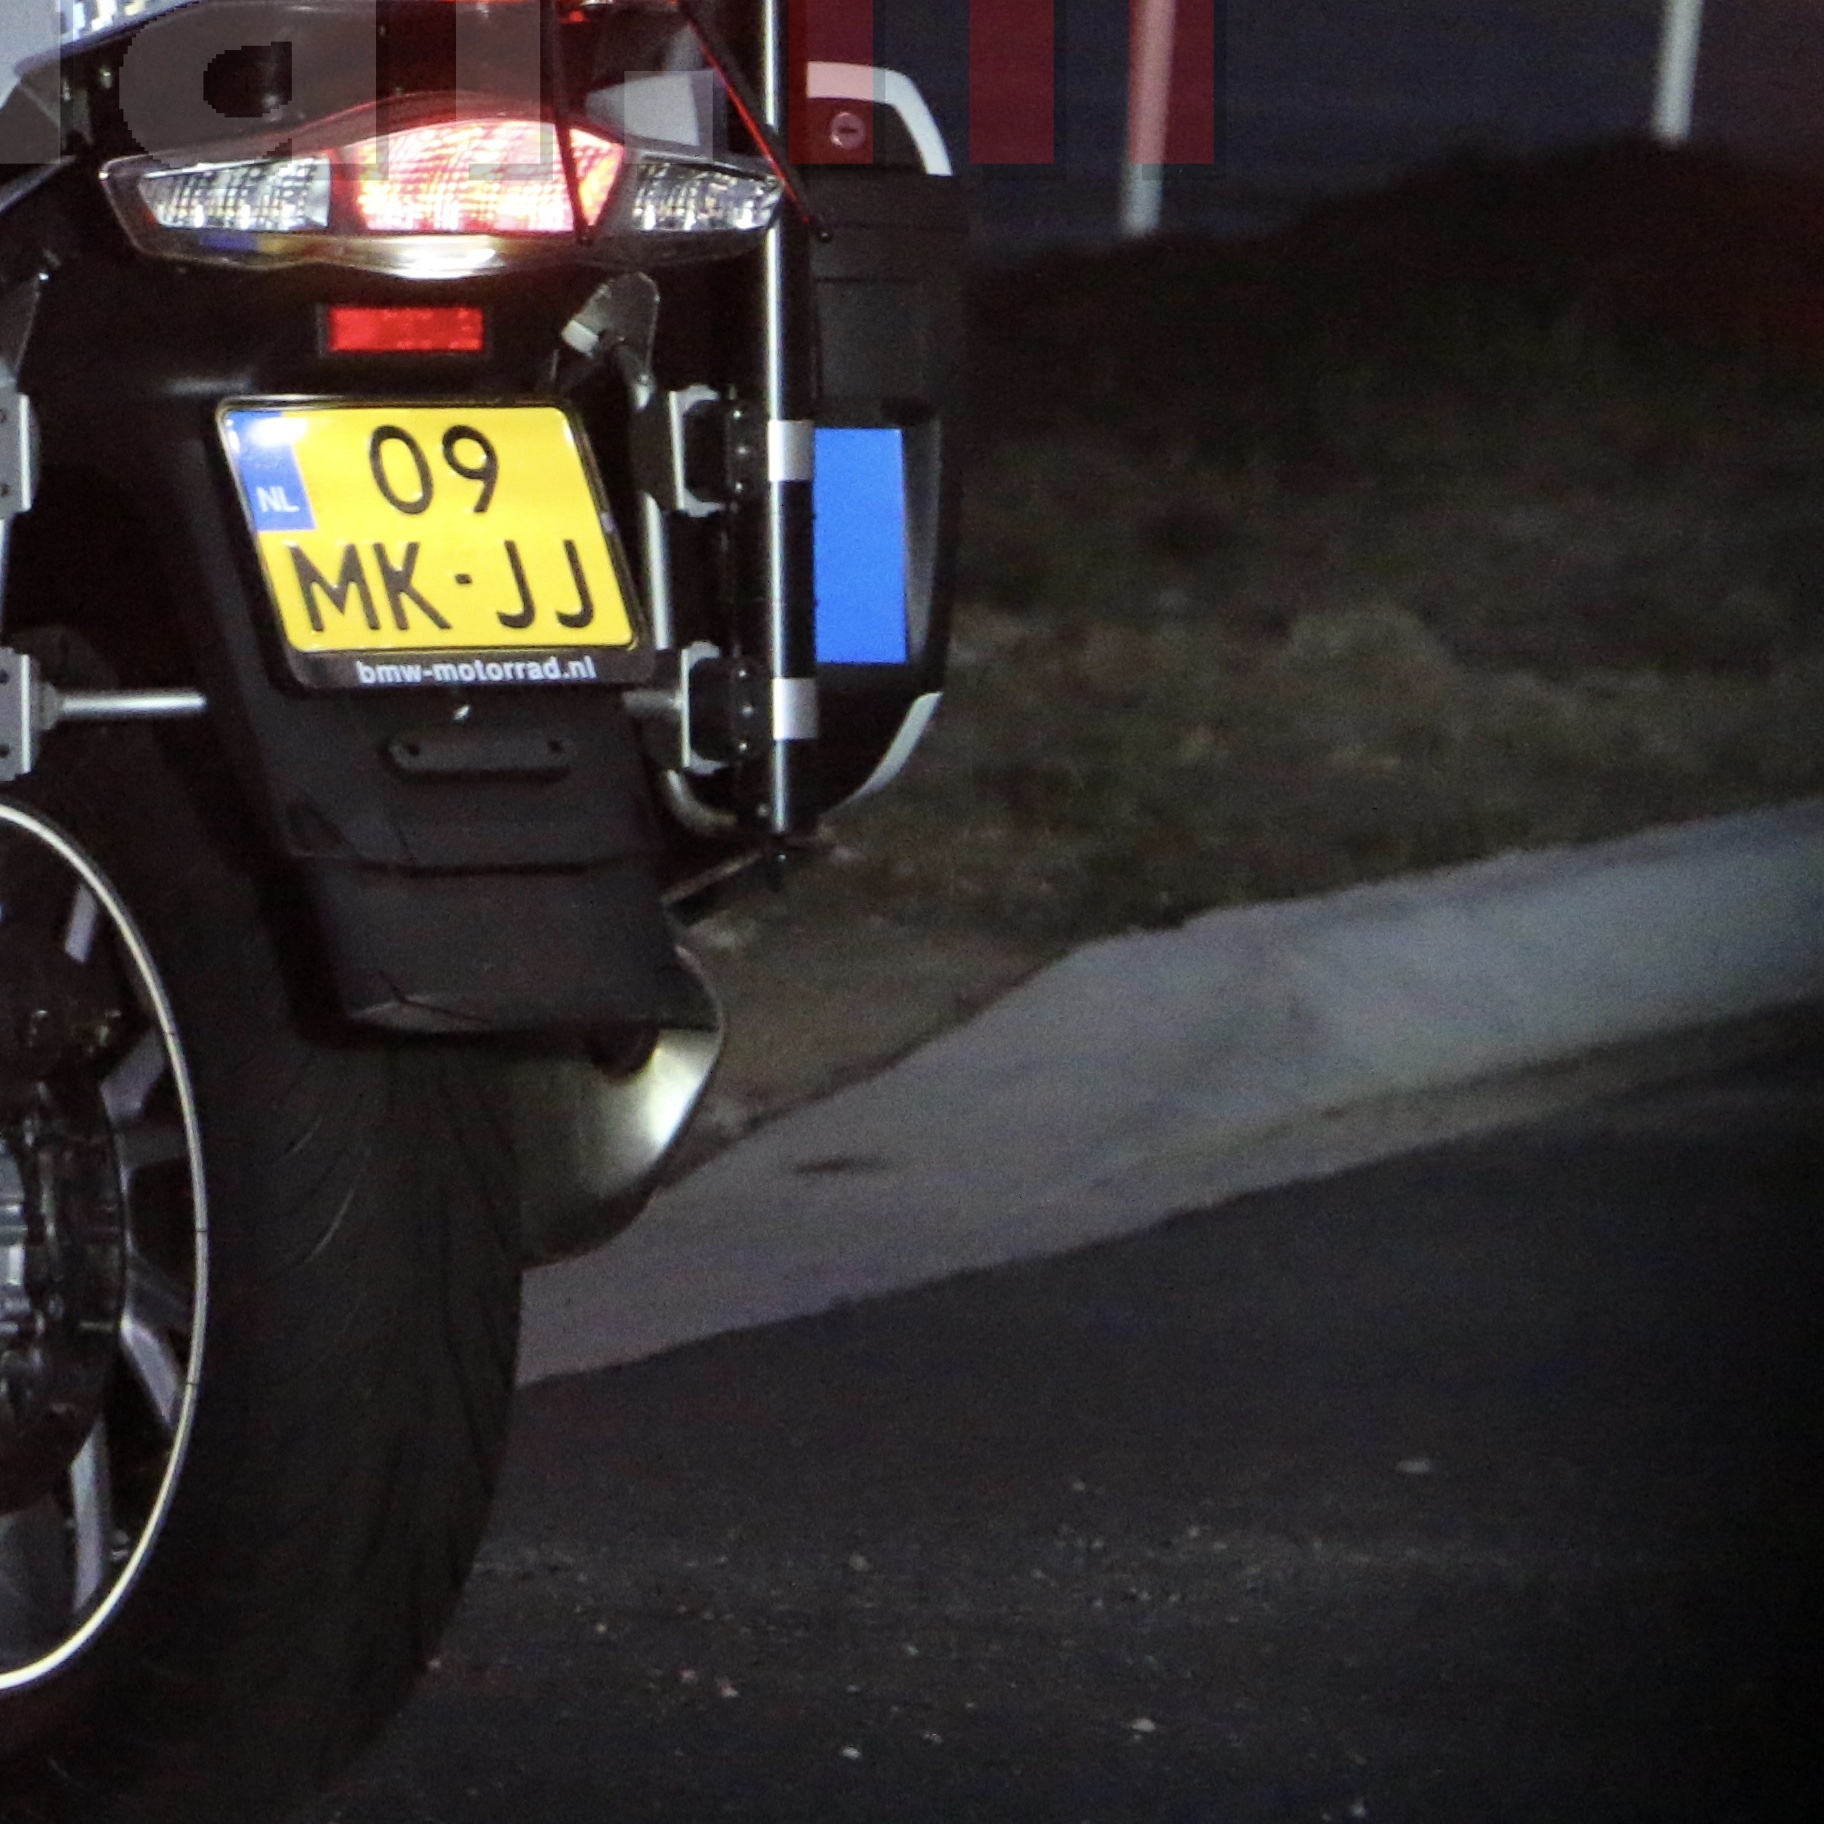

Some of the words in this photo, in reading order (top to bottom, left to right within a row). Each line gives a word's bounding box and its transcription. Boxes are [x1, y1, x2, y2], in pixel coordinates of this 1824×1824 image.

[368, 424, 500, 515] 09
[255, 486, 300, 513] NL
[356, 655, 597, 685] bmw-motorrad.nl
